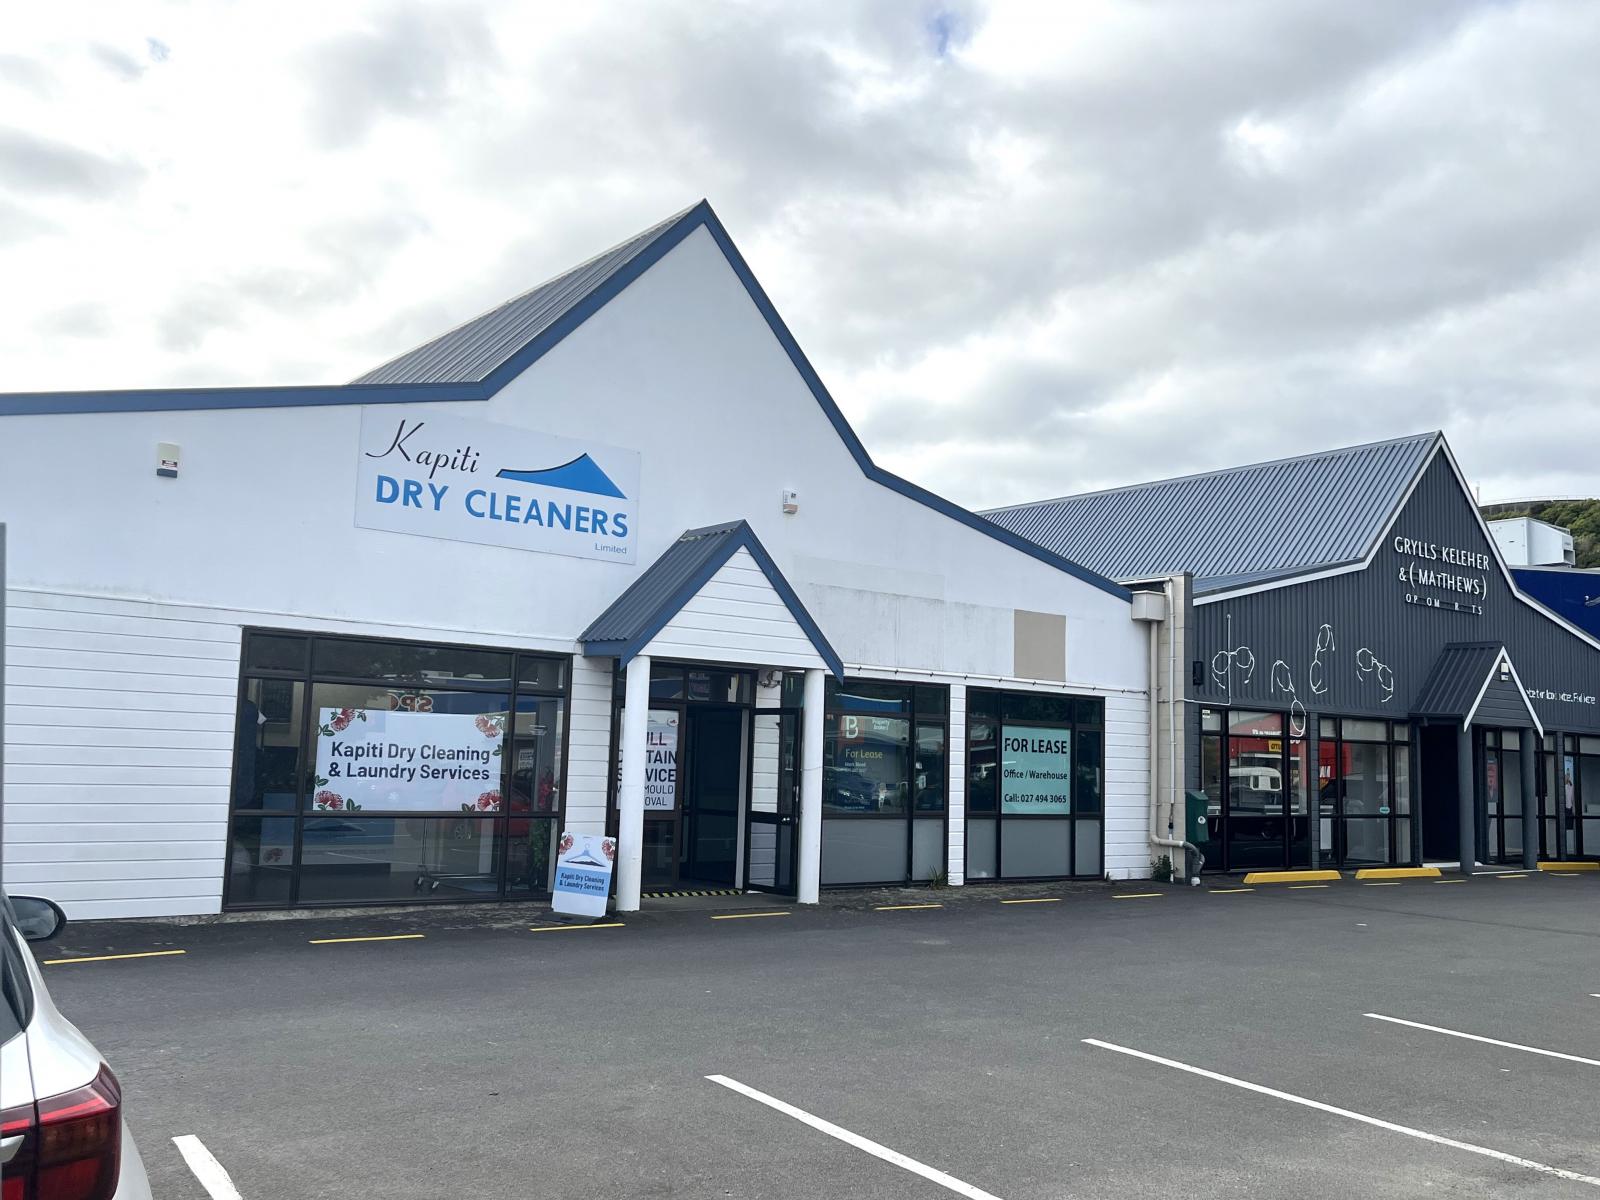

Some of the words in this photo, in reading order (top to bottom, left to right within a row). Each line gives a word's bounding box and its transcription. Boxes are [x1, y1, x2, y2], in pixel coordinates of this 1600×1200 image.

[365, 419, 480, 479] Kapiti
[376, 475, 449, 511] DRY
[465, 489, 628, 537] CLEANERS
[595, 543, 627, 555] Limited
[1394, 536, 1437, 560] GRYLLS
[1442, 546, 1490, 571] KELEHER
[1398, 567, 1407, 582] &
[331, 741, 383, 761] Kapiti
[388, 743, 416, 763] Dry
[420, 744, 490, 765] Cleaning
[845, 748, 859, 758] For
[860, 749, 884, 759] Lease
[1004, 737, 1028, 753] FOR
[1031, 738, 1067, 754] LEASE
[328, 761, 341, 777] &
[346, 762, 416, 782] Laundry
[420, 764, 490, 780] Services
[1004, 769, 1024, 778] Office
[1029, 770, 1067, 780] Warehouse
[1004, 793, 1019, 803] Call:
[1020, 794, 1034, 803] 027
[1035, 795, 1049, 803] 494
